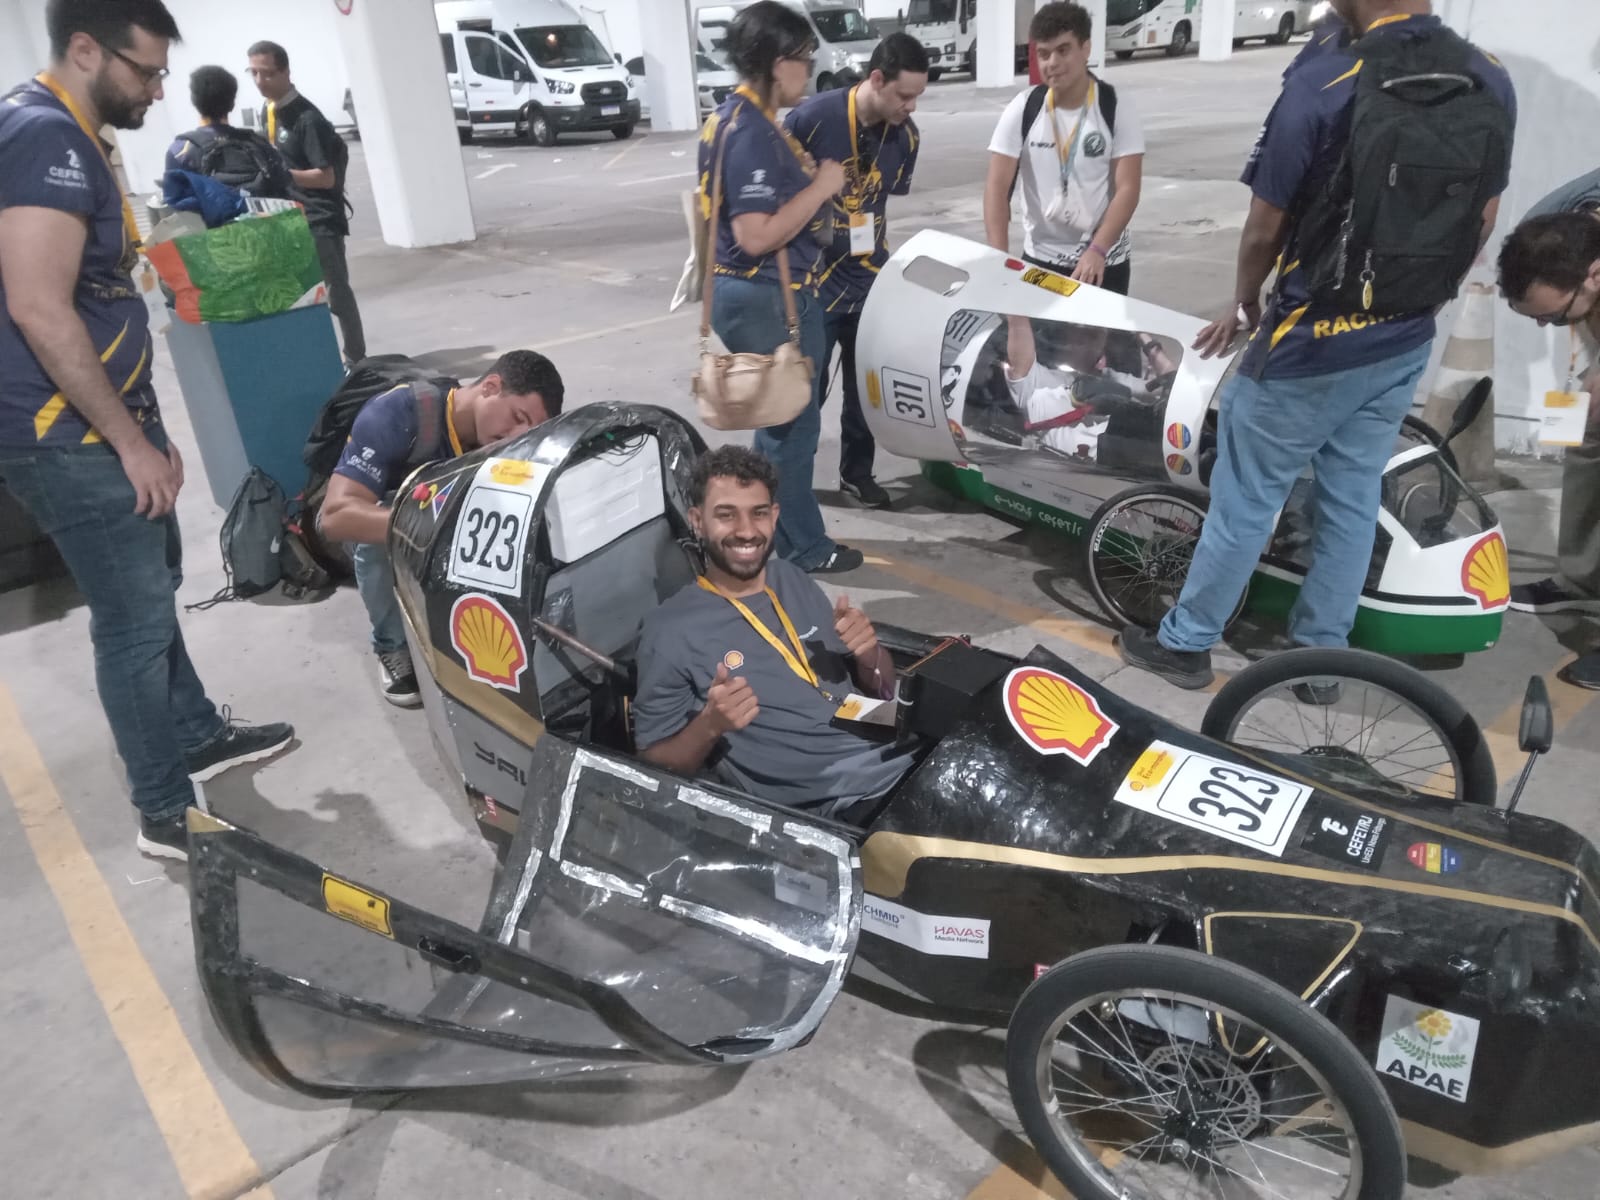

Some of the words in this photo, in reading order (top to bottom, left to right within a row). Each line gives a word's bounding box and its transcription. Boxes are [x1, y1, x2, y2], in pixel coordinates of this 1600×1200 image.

[893, 380, 926, 418] 311
[460, 508, 519, 572] 323
[1188, 766, 1280, 832] 323
[1345, 815, 1373, 855] CEFET/RJ
[934, 926, 985, 939] HAVAS
[1386, 1059, 1464, 1098] APAE
